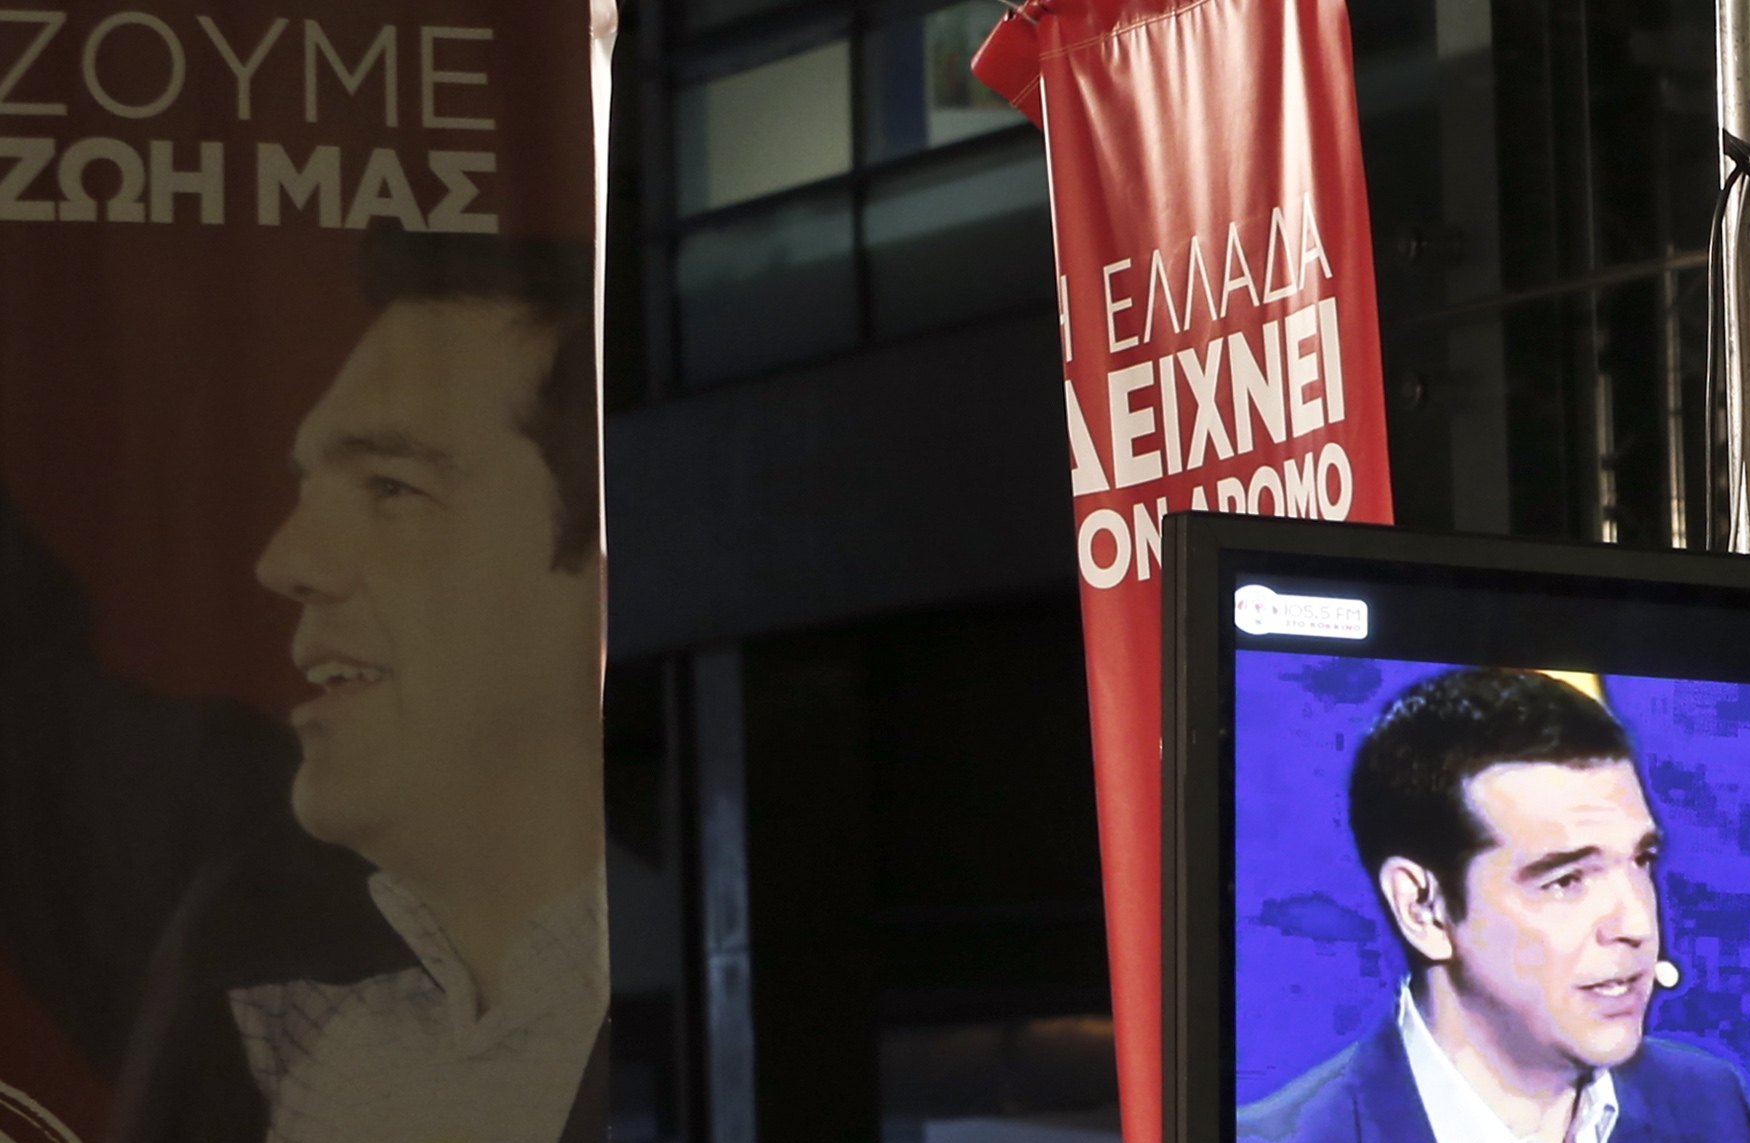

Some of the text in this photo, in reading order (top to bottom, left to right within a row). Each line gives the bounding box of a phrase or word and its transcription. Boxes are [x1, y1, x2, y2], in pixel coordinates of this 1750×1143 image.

[0, 136, 500, 235] ΖΩΗ ΜΑΣ
[1103, 191, 1333, 354] ΕΛΛΑΔΑ
[1064, 297, 1346, 497] ΔΕΙΧΝΕΙ
